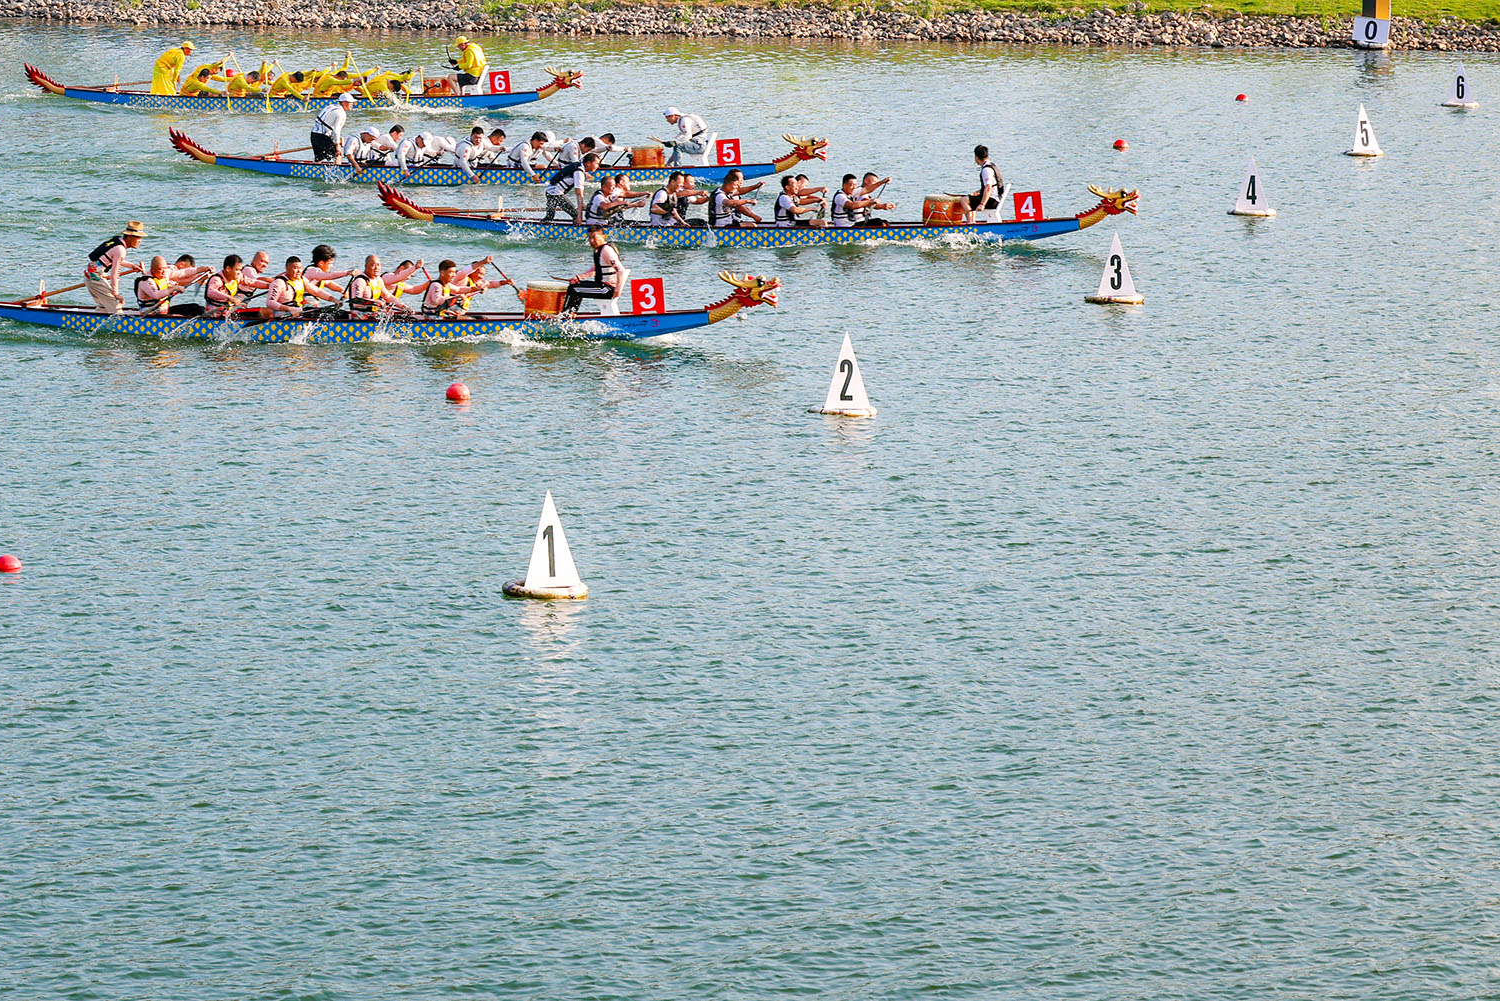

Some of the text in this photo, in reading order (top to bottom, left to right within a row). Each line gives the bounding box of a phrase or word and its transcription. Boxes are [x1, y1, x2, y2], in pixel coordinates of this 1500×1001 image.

[1364, 20, 1378, 40] 0
[494, 74, 506, 91] 6
[1456, 75, 1465, 100] 6
[1359, 120, 1370, 147] 5
[722, 142, 736, 162] 5
[1246, 174, 1257, 205] 4
[1020, 195, 1037, 217] 4
[1110, 254, 1122, 290] 3
[638, 283, 657, 310] 3
[839, 359, 854, 401] 2
[542, 525, 556, 577] 1
